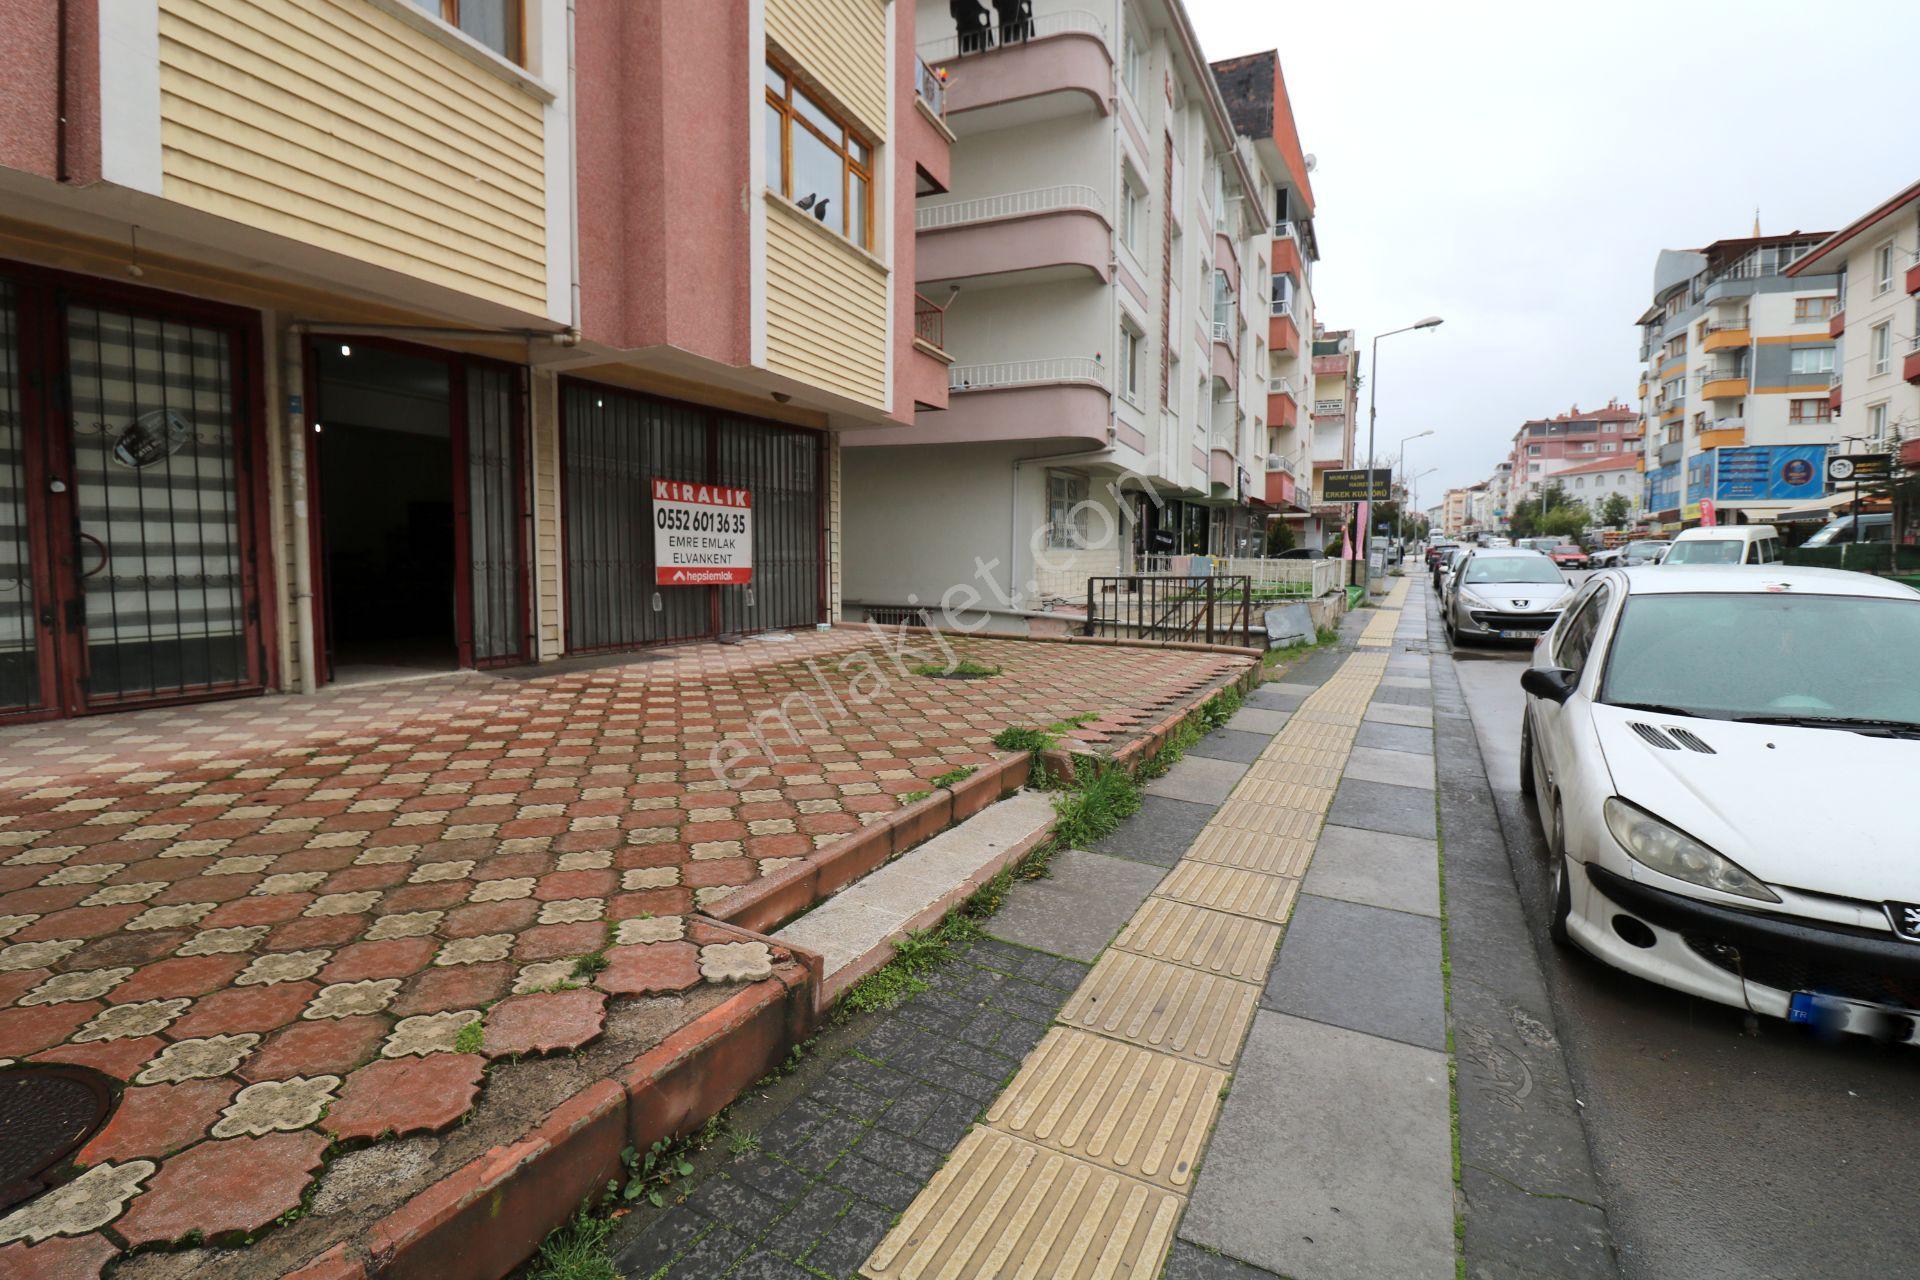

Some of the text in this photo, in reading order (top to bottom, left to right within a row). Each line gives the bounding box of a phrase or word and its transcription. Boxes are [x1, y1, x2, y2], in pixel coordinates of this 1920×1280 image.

[655, 481, 746, 507] KİRALIK
[1325, 488, 1387, 498] ERKEK KUAÖRÜ
[657, 507, 745, 534] 0552 601 36 35
[669, 535, 736, 549] EMRE EMLAK
[673, 552, 733, 564] ELVANKENT
[686, 570, 733, 583] hepsiemlak
[1792, 1009, 1807, 1018] TR
